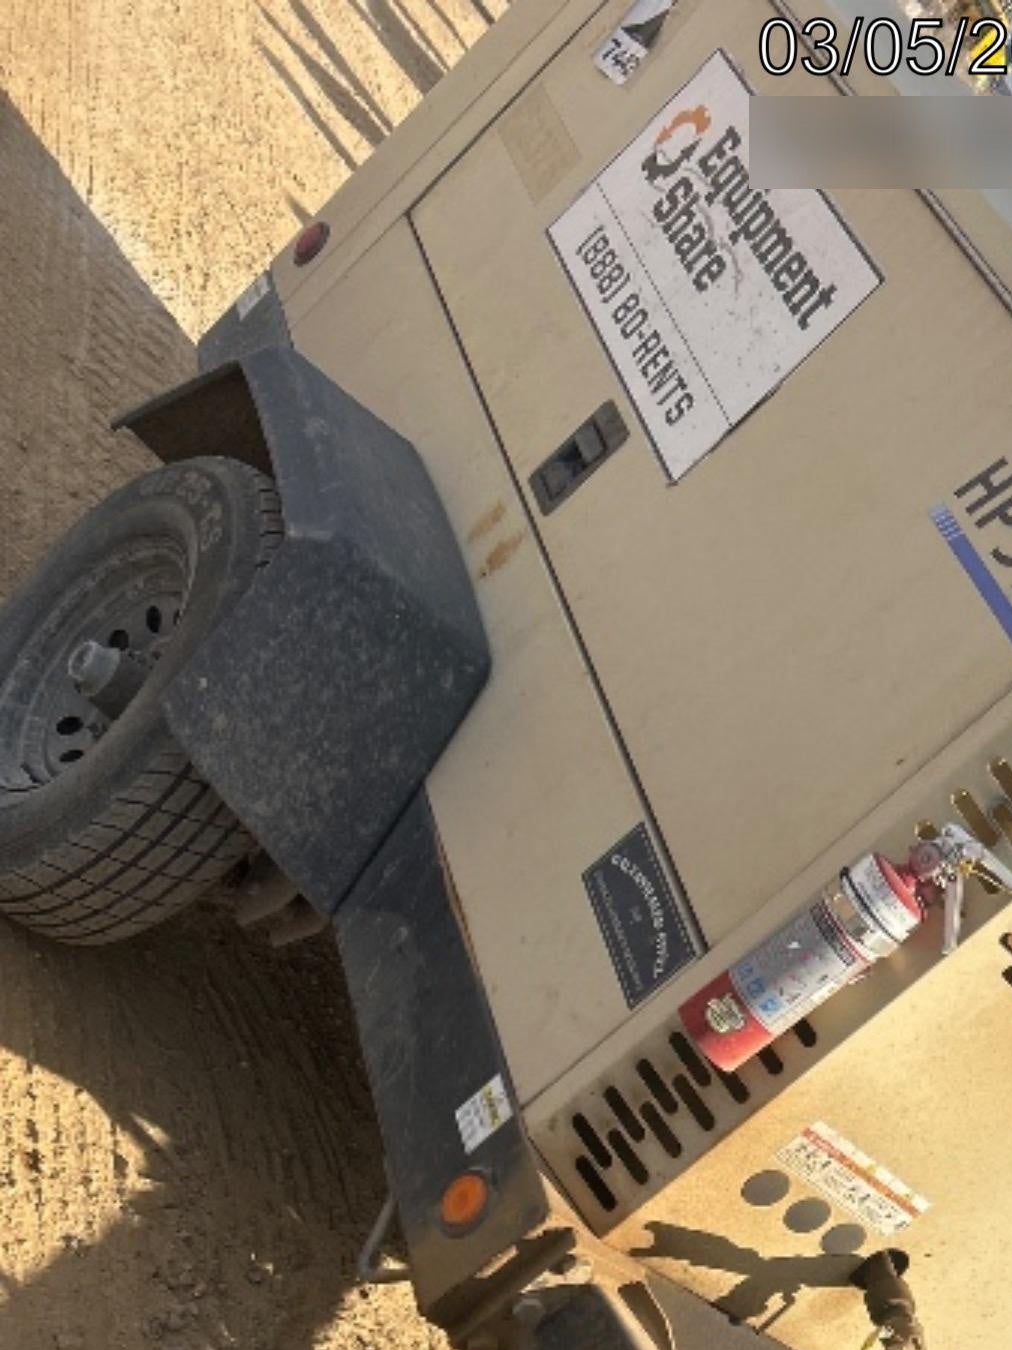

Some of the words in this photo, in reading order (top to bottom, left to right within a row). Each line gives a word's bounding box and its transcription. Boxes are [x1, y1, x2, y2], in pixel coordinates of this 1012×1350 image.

[576, 225, 631, 304] (888)
[612, 293, 695, 426] 80-RENTS
[653, 176, 727, 293] Share
[698, 126, 838, 331] Equipment
